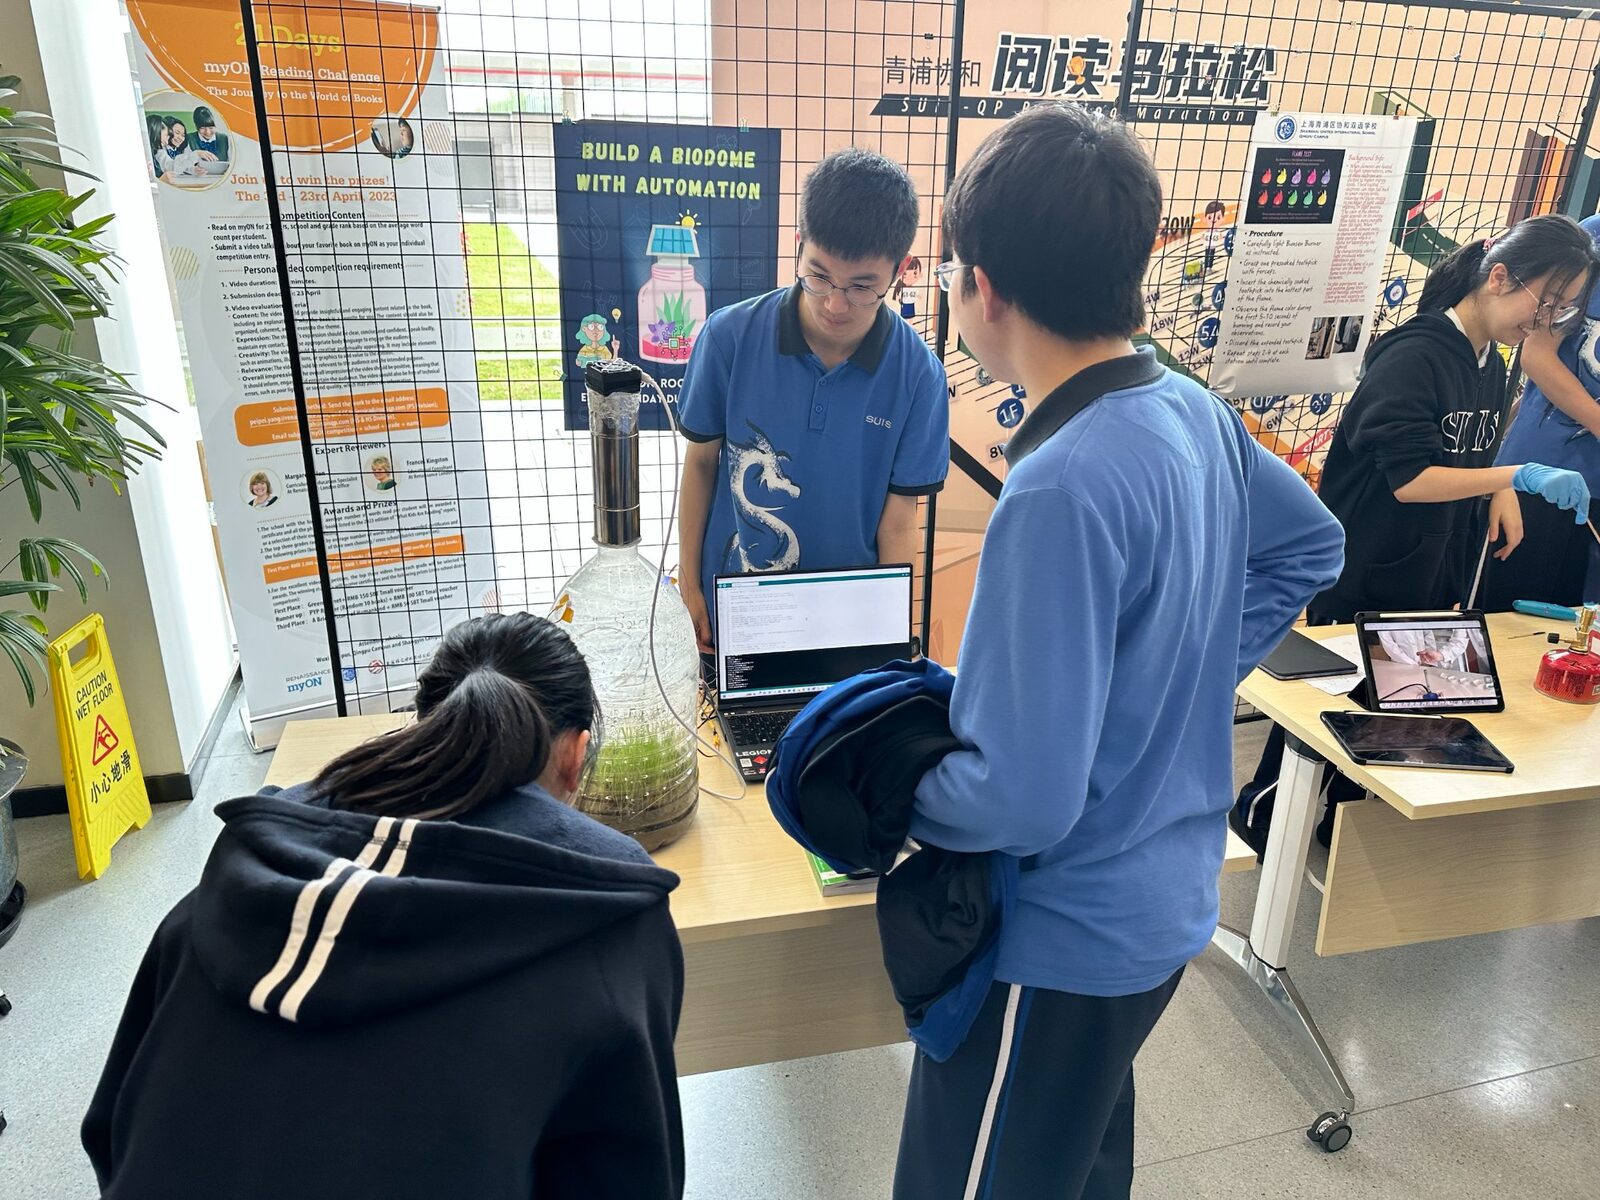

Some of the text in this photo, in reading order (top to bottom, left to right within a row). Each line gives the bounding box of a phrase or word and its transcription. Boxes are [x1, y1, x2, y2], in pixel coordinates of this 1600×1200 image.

[273, 24, 342, 57] Days
[991, 33, 1276, 101] 阅读马拉松
[261, 65, 314, 81] Reading
[207, 86, 228, 96] The
[290, 91, 307, 100] the
[310, 91, 339, 101] World
[354, 94, 383, 104] Books
[1136, 106, 1245, 122] Marathon
[581, 141, 756, 169] BUILD A BIODOME
[230, 174, 258, 185] Join
[296, 174, 322, 186] win
[325, 175, 345, 186] the
[348, 174, 390, 187] prizes!
[576, 173, 761, 200] WITH AUTOMATION
[235, 190, 260, 201] The
[300, 190, 329, 201] 23rd
[369, 191, 396, 201] 2023
[332, 210, 365, 220] Content
[237, 223, 255, 232] myON
[1249, 230, 1284, 238] Procedure
[302, 242, 315, 250] your
[1246, 239, 1322, 248] Carefully light Bunsen Burner
[216, 253, 271, 261] competition entry.
[1243, 259, 1259, 267] Grasp
[1295, 258, 1318, 266] toothpick
[1240, 278, 1256, 286] Insert
[1267, 277, 1293, 287] chemically
[230, 292, 266, 300] Submission
[306, 289, 321, 297] April
[1268, 305, 1284, 314] flame
[1152, 314, 1174, 333] 18W
[1178, 345, 1200, 363] 12W
[240, 366, 274, 374] Relevance:
[242, 373, 264, 382] Overall
[999, 403, 1019, 424] 1F
[865, 414, 892, 429] SUIS
[315, 443, 386, 455] Expert Reviewers
[323, 505, 354, 515] Awards
[274, 607, 286, 615] First
[275, 613, 295, 622] Runner
[277, 622, 291, 631] Third
[291, 620, 306, 628] Place
[76, 669, 107, 704] CAUTION
[287, 676, 323, 693] myON
[75, 682, 114, 721] WET FLOOR
[90, 748, 132, 804] 小心地滑
